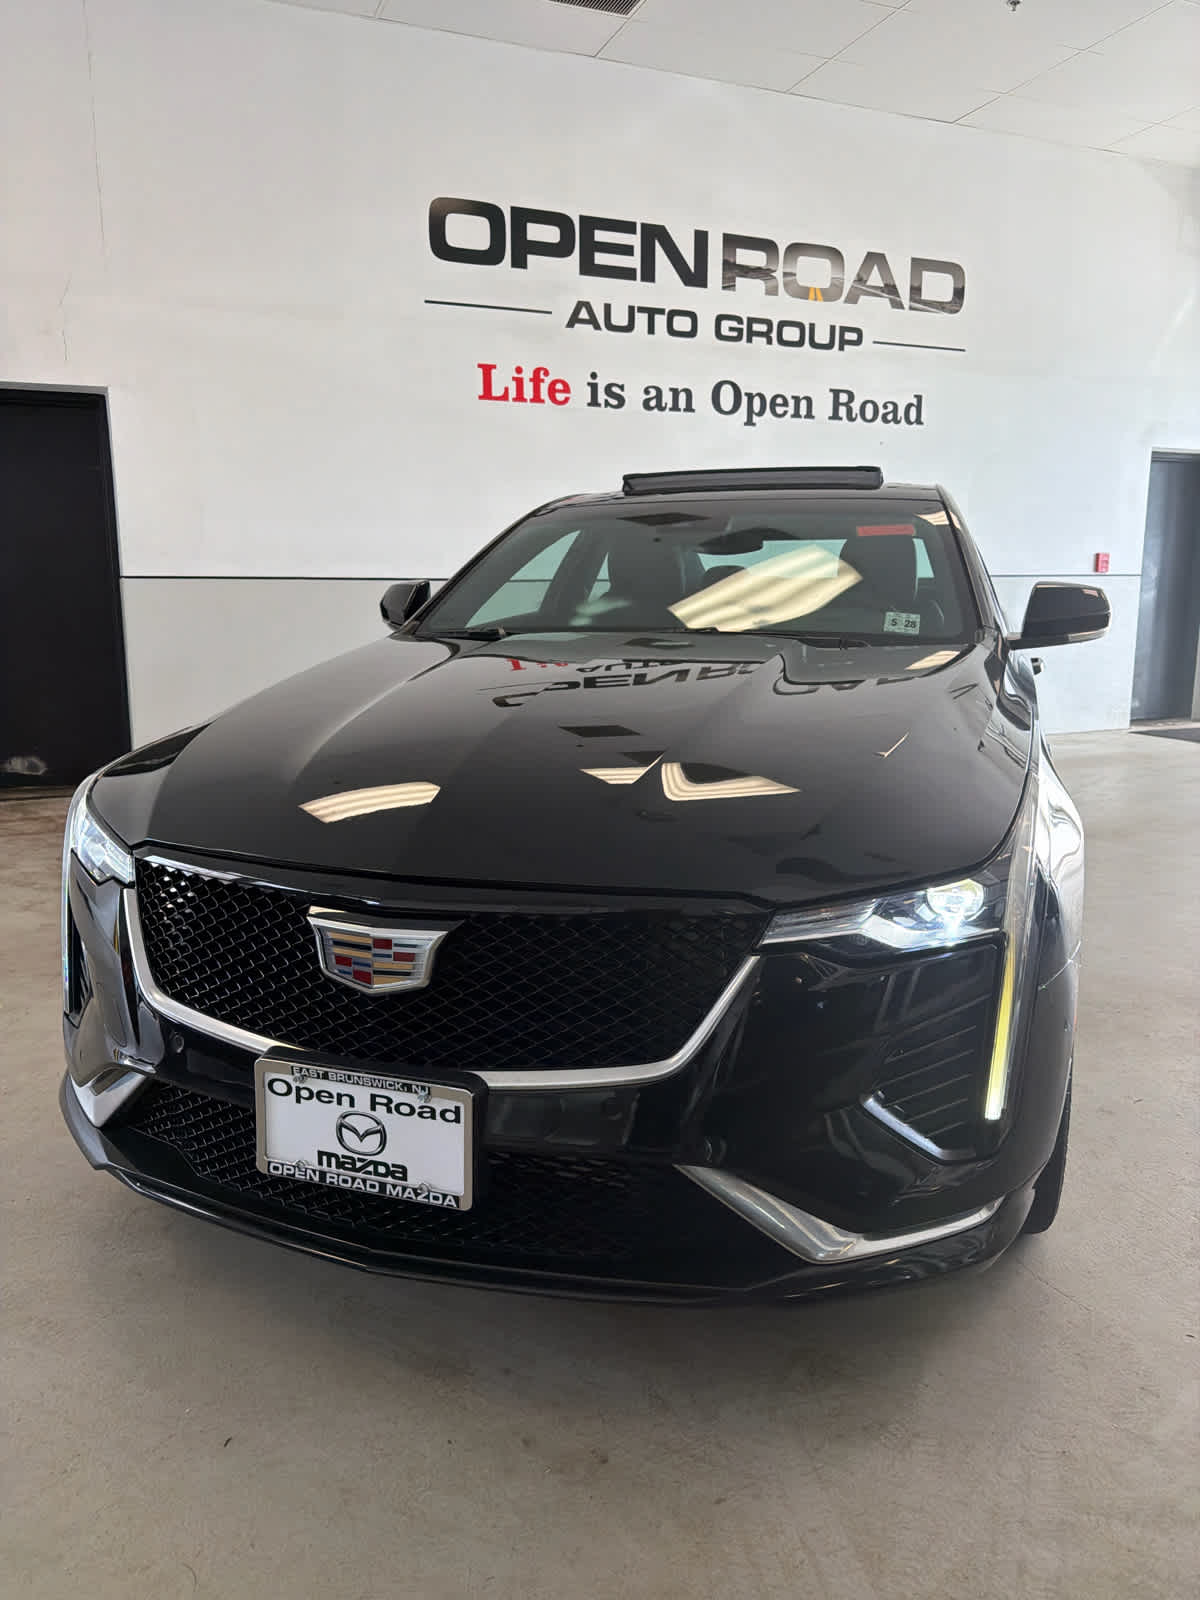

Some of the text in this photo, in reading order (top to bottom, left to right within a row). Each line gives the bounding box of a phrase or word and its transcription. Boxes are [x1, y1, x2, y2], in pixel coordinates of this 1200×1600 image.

[429, 197, 966, 315] OPEN ROAD
[565, 301, 864, 352] AUTO GROUP
[477, 363, 924, 427] Life is an Open Road
[267, 1078, 461, 1124] Open Road
[293, 1067, 324, 1080] EAST
[412, 1084, 430, 1095] NJ
[269, 1163, 457, 1208] OPEN ROAD MAZDA
